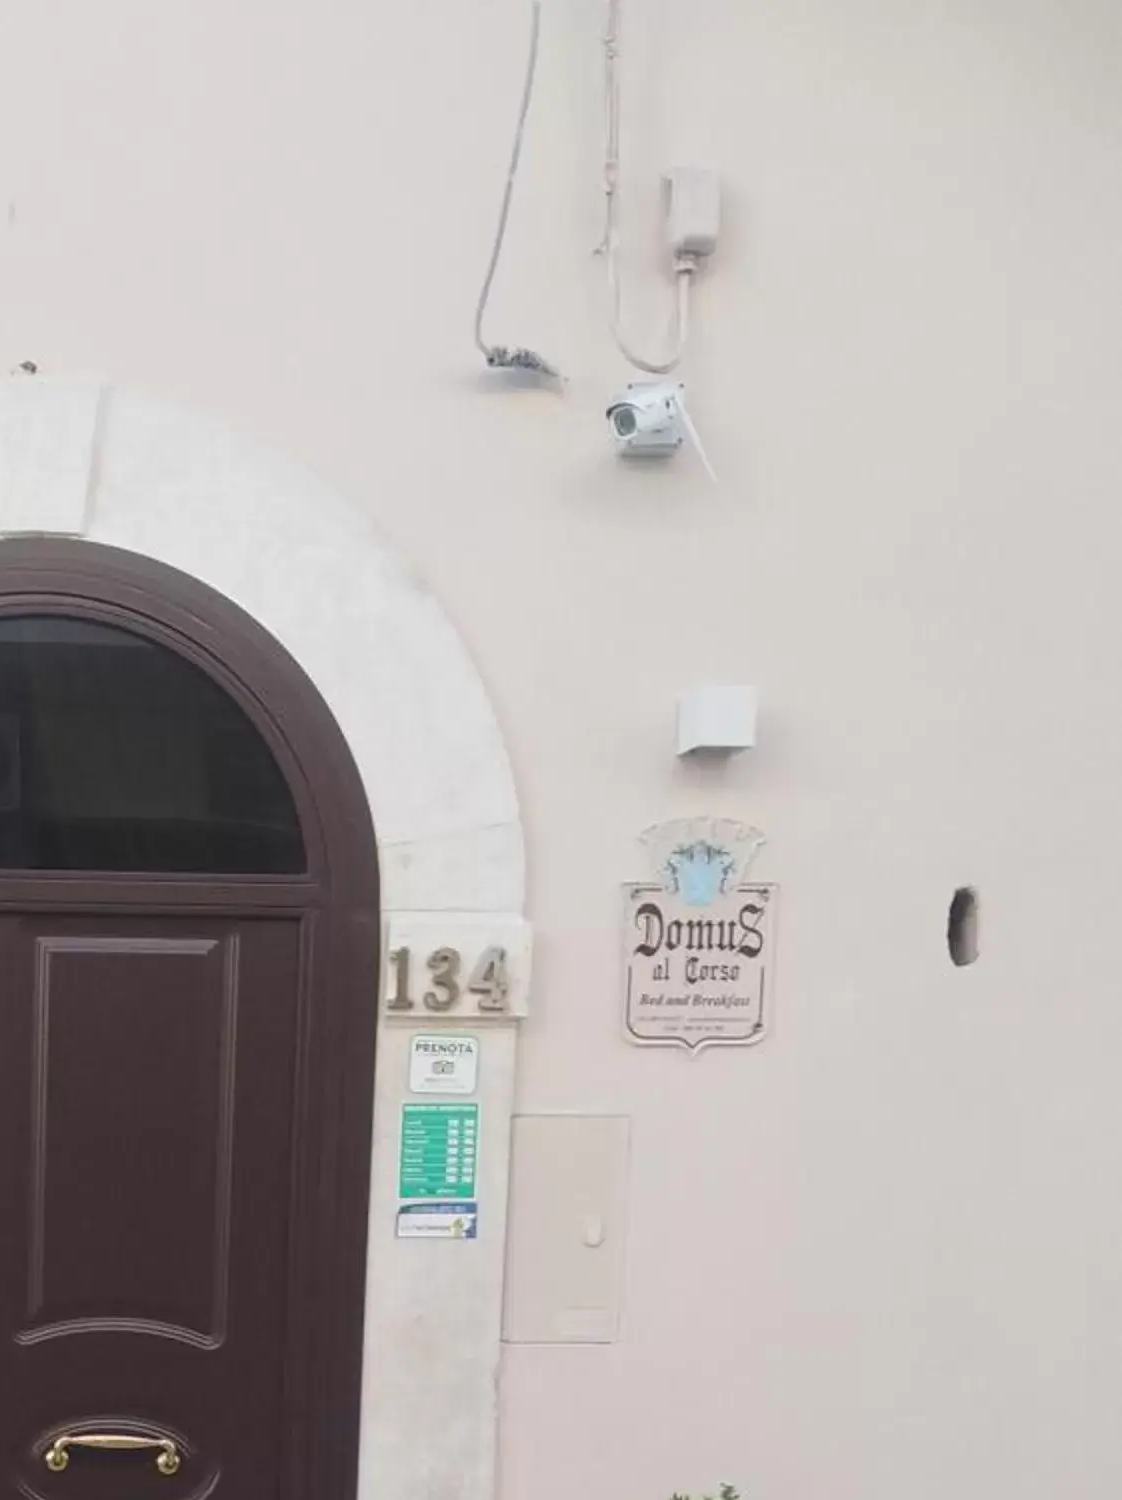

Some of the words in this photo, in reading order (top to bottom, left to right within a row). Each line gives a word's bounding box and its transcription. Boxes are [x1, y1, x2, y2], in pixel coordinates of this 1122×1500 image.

[387, 946, 507, 1011] 134
[652, 957, 670, 981] al
[685, 956, 739, 984] Corso
[639, 994, 664, 1006] Bed
[665, 995, 690, 1006] and
[691, 994, 751, 1008] Breakfast
[415, 1043, 473, 1053] PRENOTA
